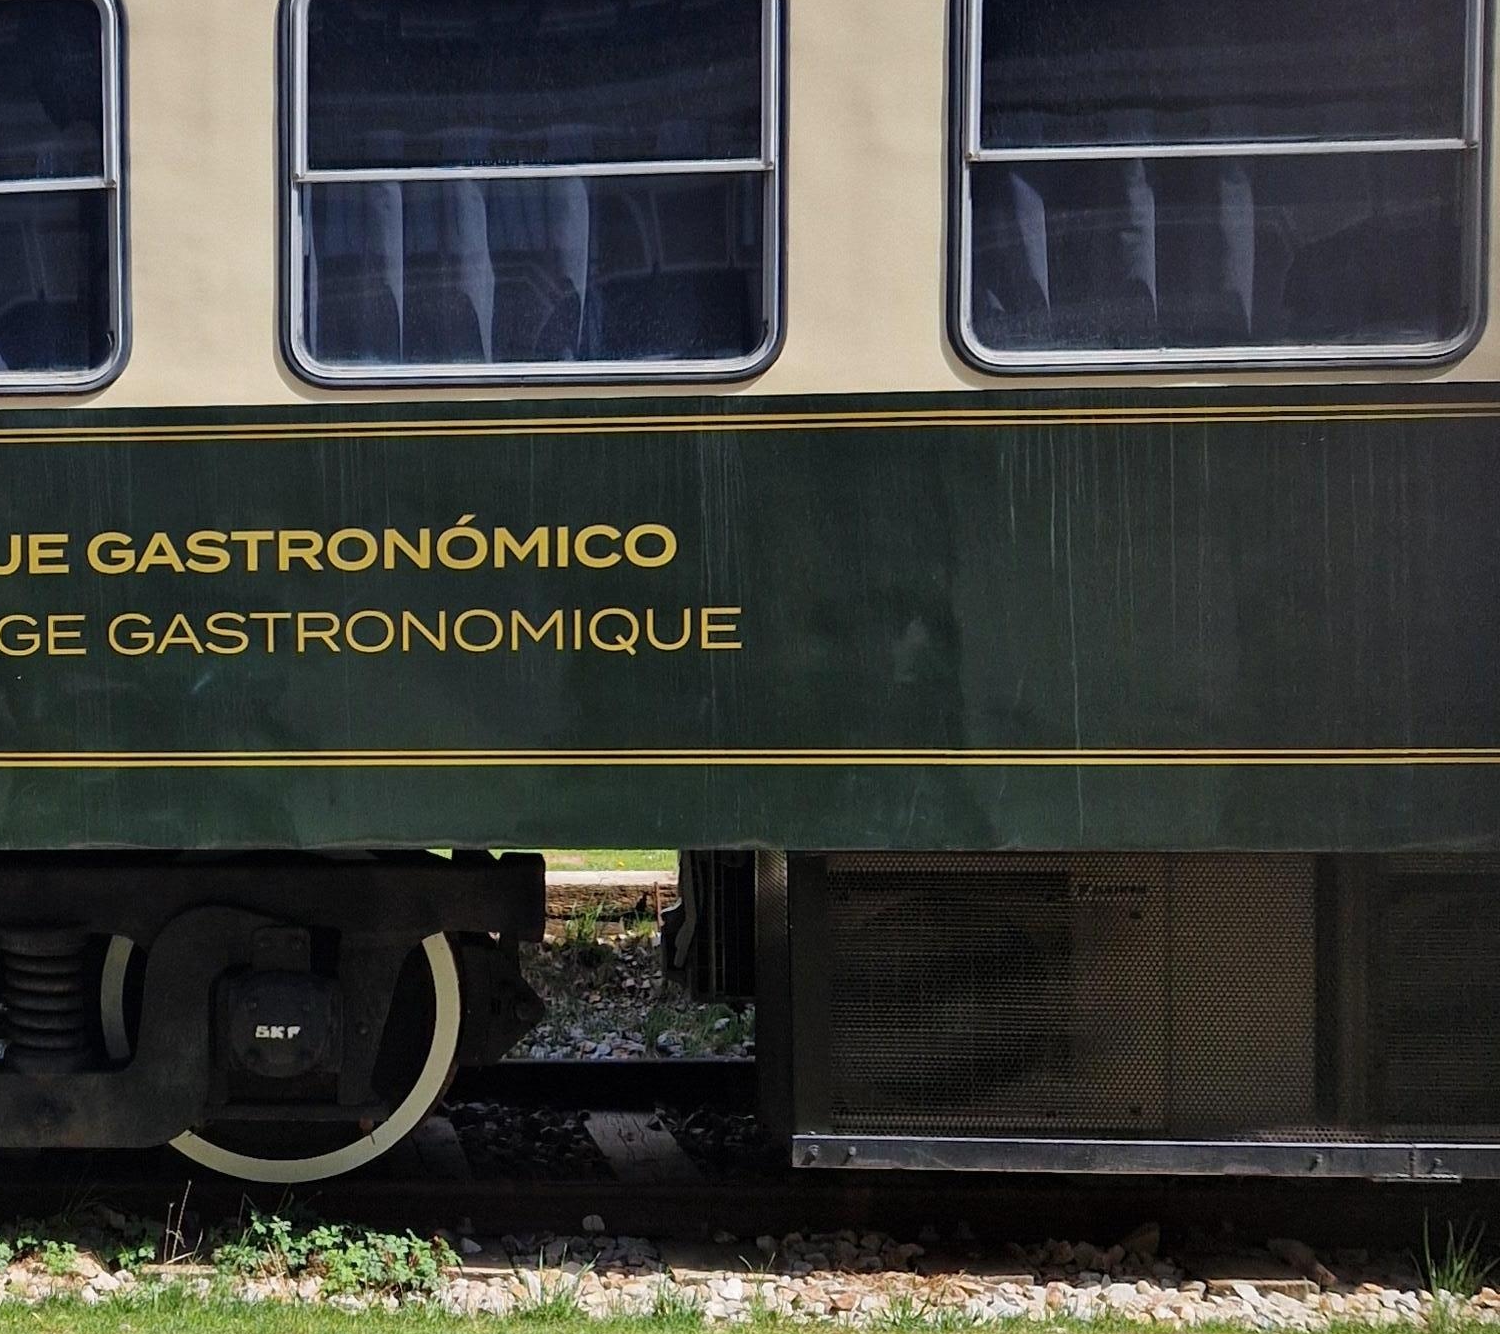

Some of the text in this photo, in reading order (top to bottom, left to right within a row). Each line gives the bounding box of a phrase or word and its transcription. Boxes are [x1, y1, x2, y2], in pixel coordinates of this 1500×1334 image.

[87, 514, 677, 575] GASTRONÓMICO
[107, 606, 743, 657] GASTRONOMIQUE
[255, 1025, 301, 1039] SKF
